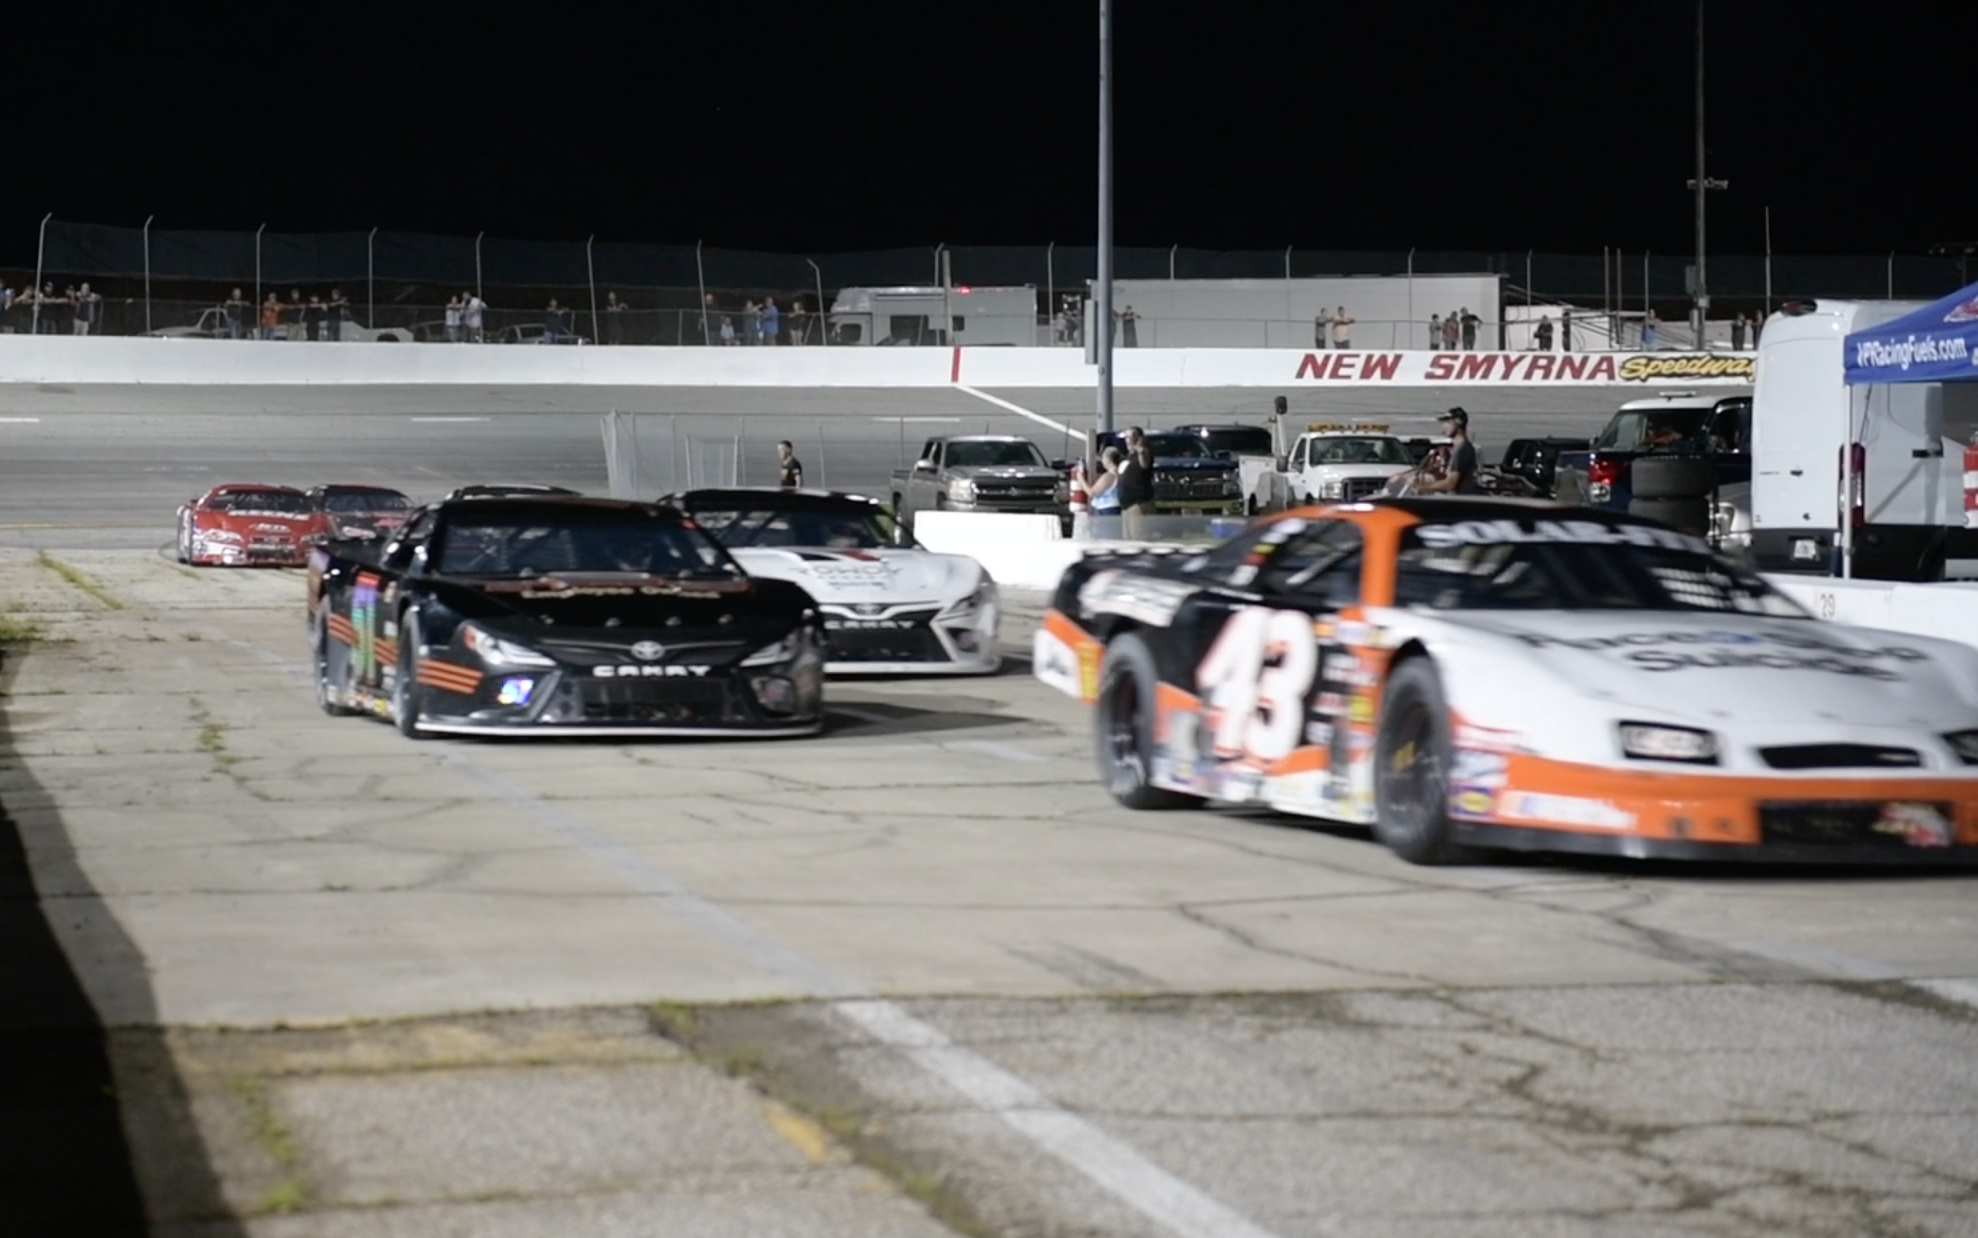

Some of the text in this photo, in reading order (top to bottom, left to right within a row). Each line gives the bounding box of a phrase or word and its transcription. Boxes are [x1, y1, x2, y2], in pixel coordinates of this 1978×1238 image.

[1295, 353, 1403, 380] NEW
[1424, 354, 1616, 381] SMYRNA
[1820, 593, 1836, 618] 29
[592, 665, 711, 677] CAMRY
[1195, 605, 1319, 762] 43
